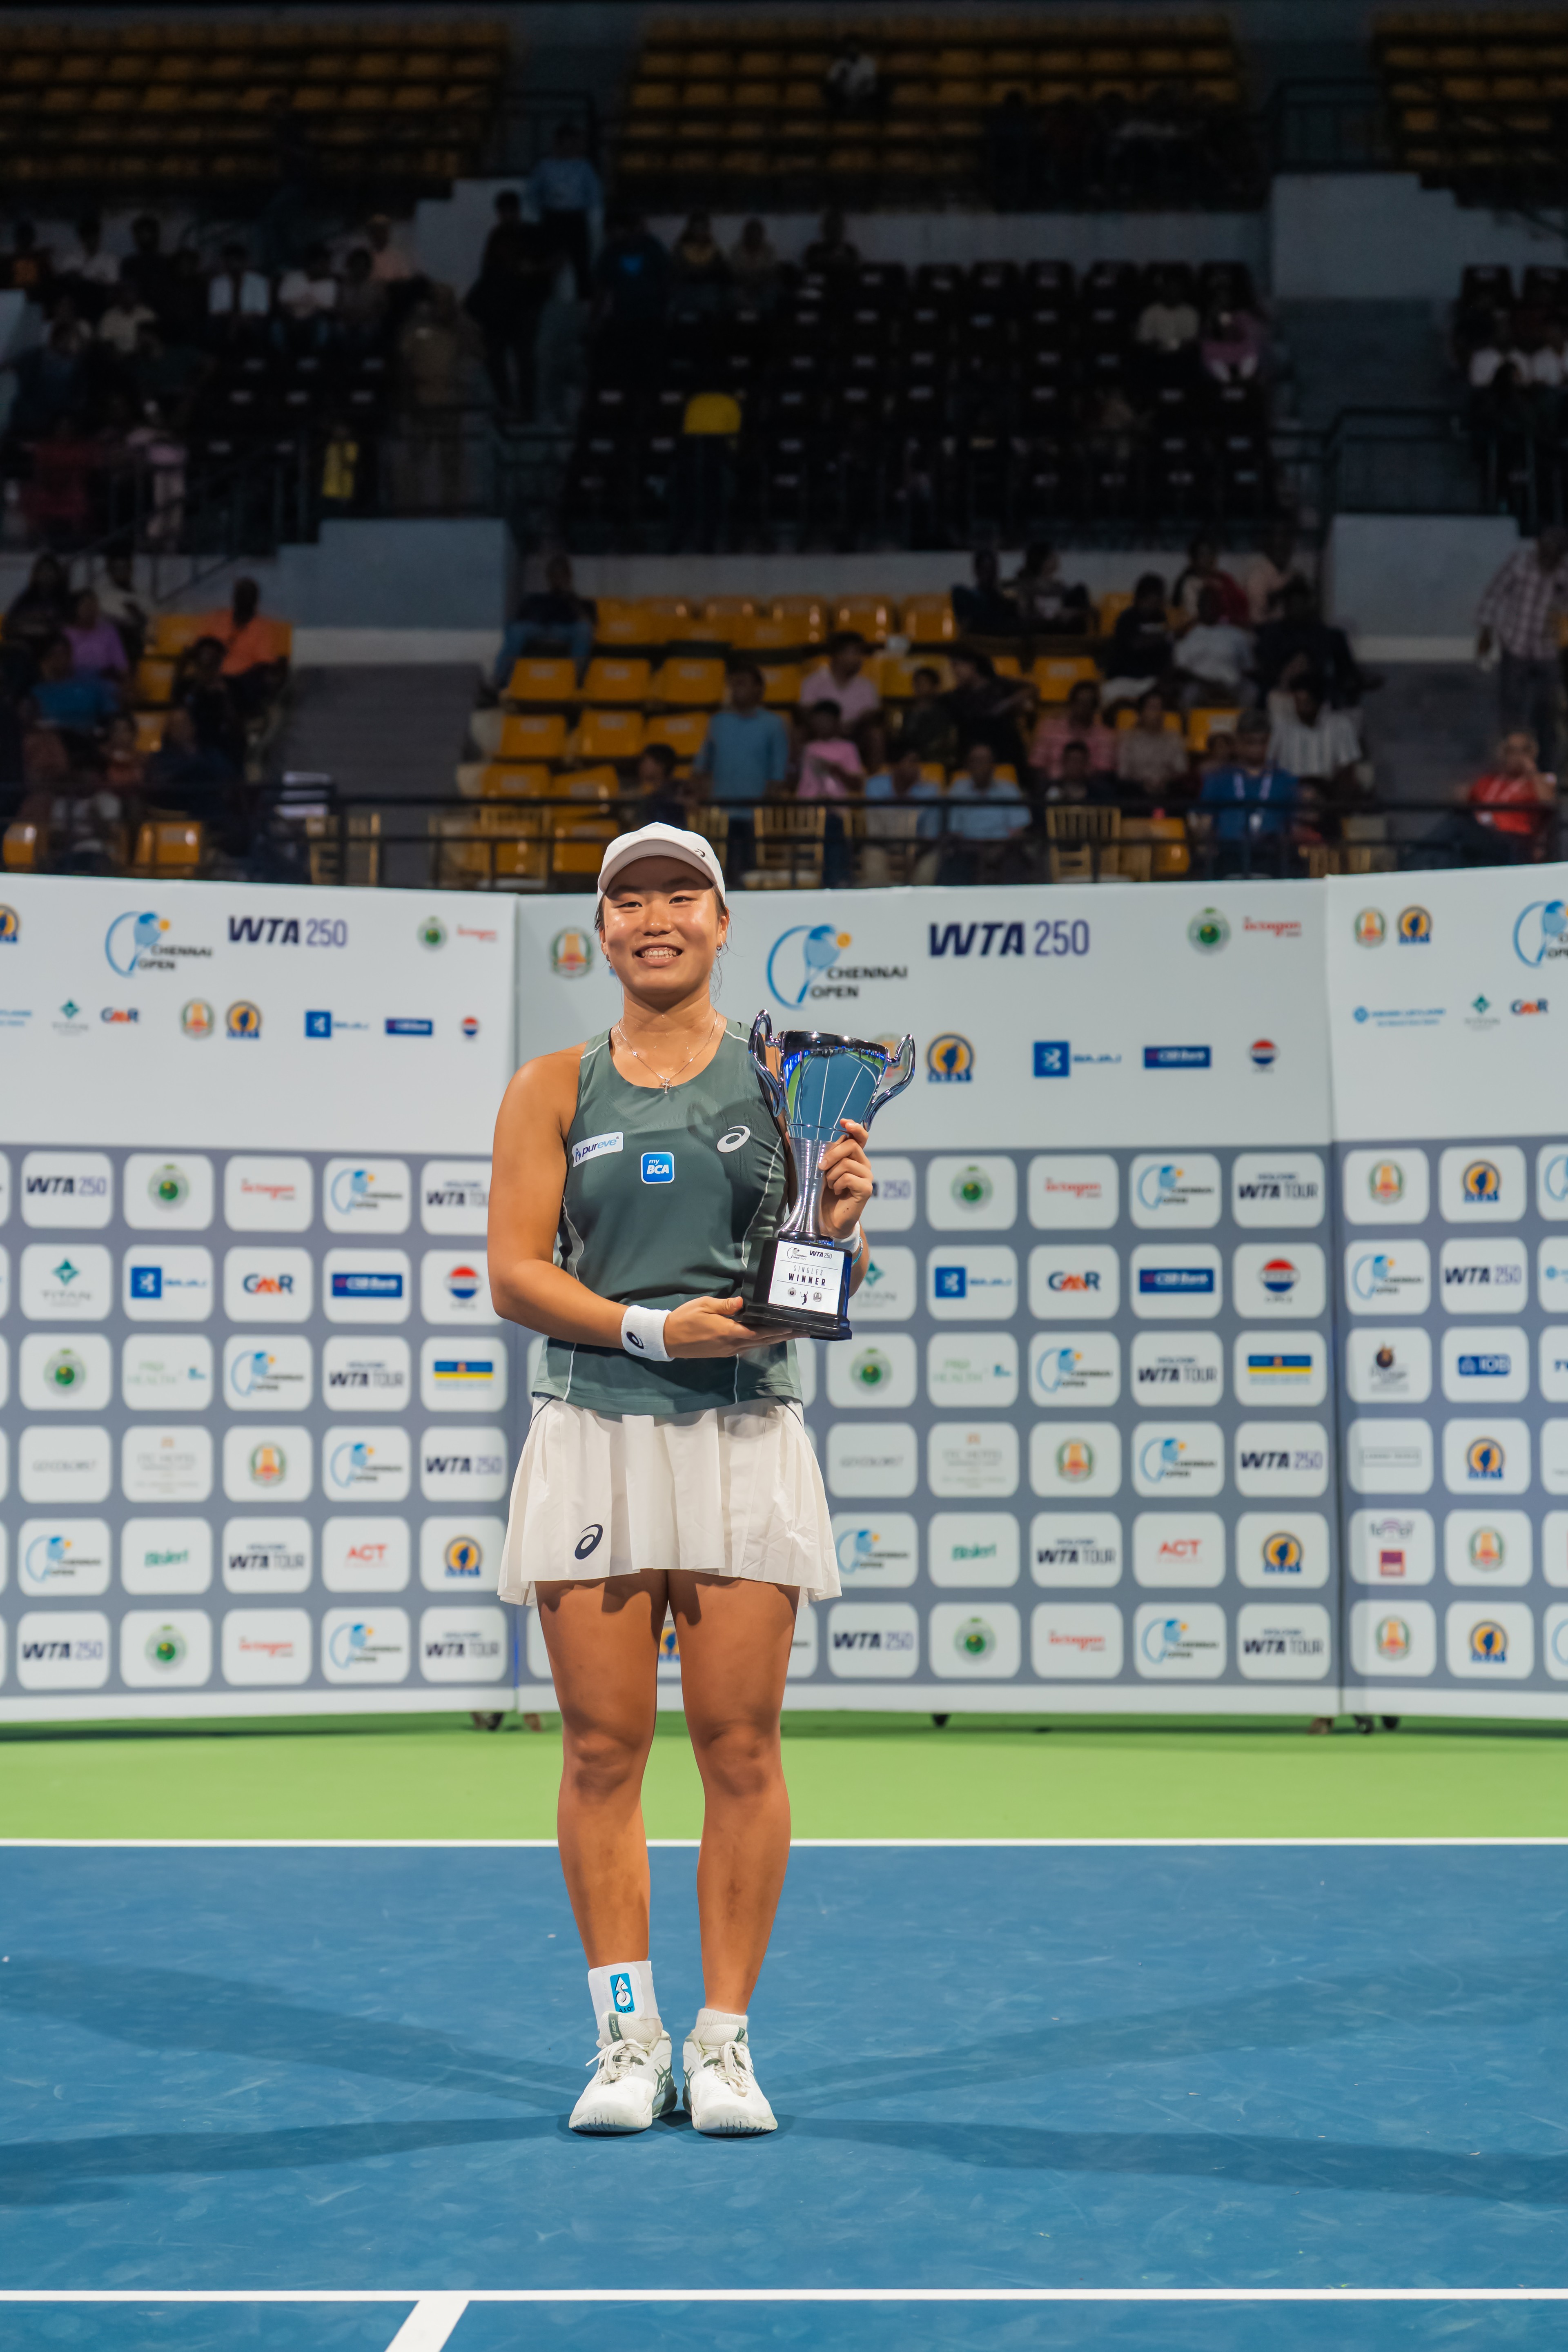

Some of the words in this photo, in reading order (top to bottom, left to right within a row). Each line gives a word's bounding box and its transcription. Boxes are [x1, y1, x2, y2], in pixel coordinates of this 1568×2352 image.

[229, 917, 299, 944] WTA
[306, 918, 347, 948] 250
[930, 922, 1024, 957] WTA
[1034, 920, 1089, 956] 250
[826, 966, 908, 980] CHENNAI
[810, 986, 859, 999] OPEN
[582, 1139, 617, 1157] pureve
[646, 1165, 669, 1174] BCA
[27, 1177, 74, 1194] WTA
[793, 1265, 823, 1276] SINGLES
[789, 1273, 825, 1286] WINNER
[1241, 1452, 1289, 1469] WTA
[347, 1544, 387, 1561] ACT
[1159, 1539, 1201, 1556] ACT
